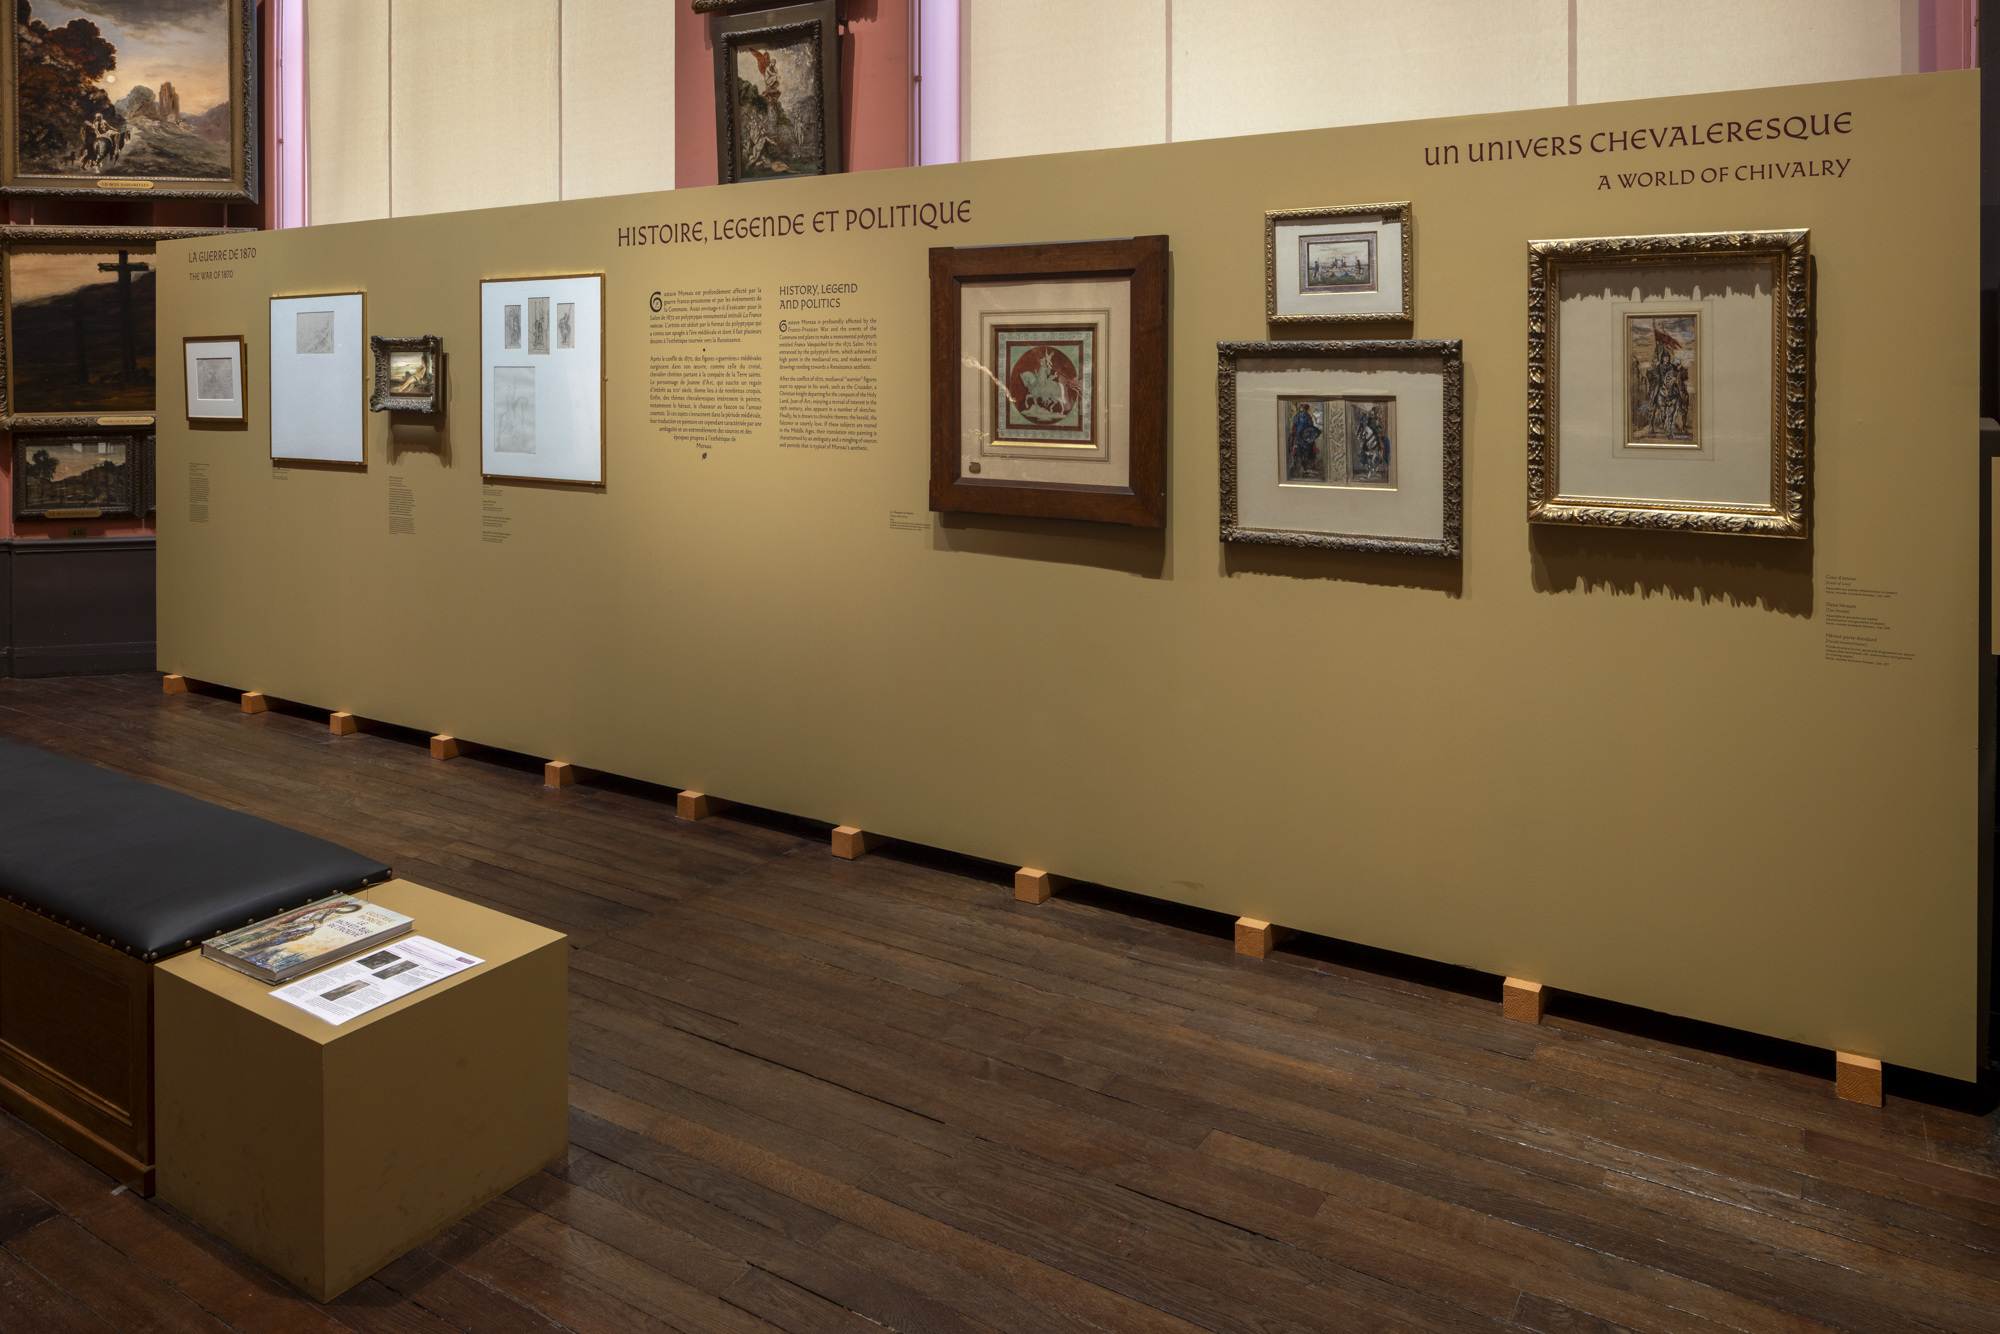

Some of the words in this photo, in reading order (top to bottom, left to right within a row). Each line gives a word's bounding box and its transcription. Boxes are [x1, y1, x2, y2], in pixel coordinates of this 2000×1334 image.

[1590, 111, 1854, 152] CHEVALERESQUE
[1597, 175, 1612, 190] A
[1616, 168, 1696, 188] WORLD
[1700, 166, 1730, 184] OF
[1734, 158, 1852, 182] CHIVALRY
[618, 222, 708, 246] HISTOIRE,
[714, 214, 805, 240] LEGENDE
[812, 210, 839, 233] ET
[846, 200, 972, 230] POLITIQUE
[189, 252, 198, 263] LA
[199, 249, 227, 262] GUERRE
[229, 249, 239, 260] DE
[240, 247, 257, 259] 1870
[189, 272, 200, 280] THE
[201, 271, 213, 280] WAR
[214, 271, 221, 279] OF
[221, 270, 233, 278] 1870
[779, 285, 819, 296] HISTORY,
[821, 283, 858, 294] LEGEND
[779, 300, 799, 310] AND
[801, 298, 841, 310] POLITICS
